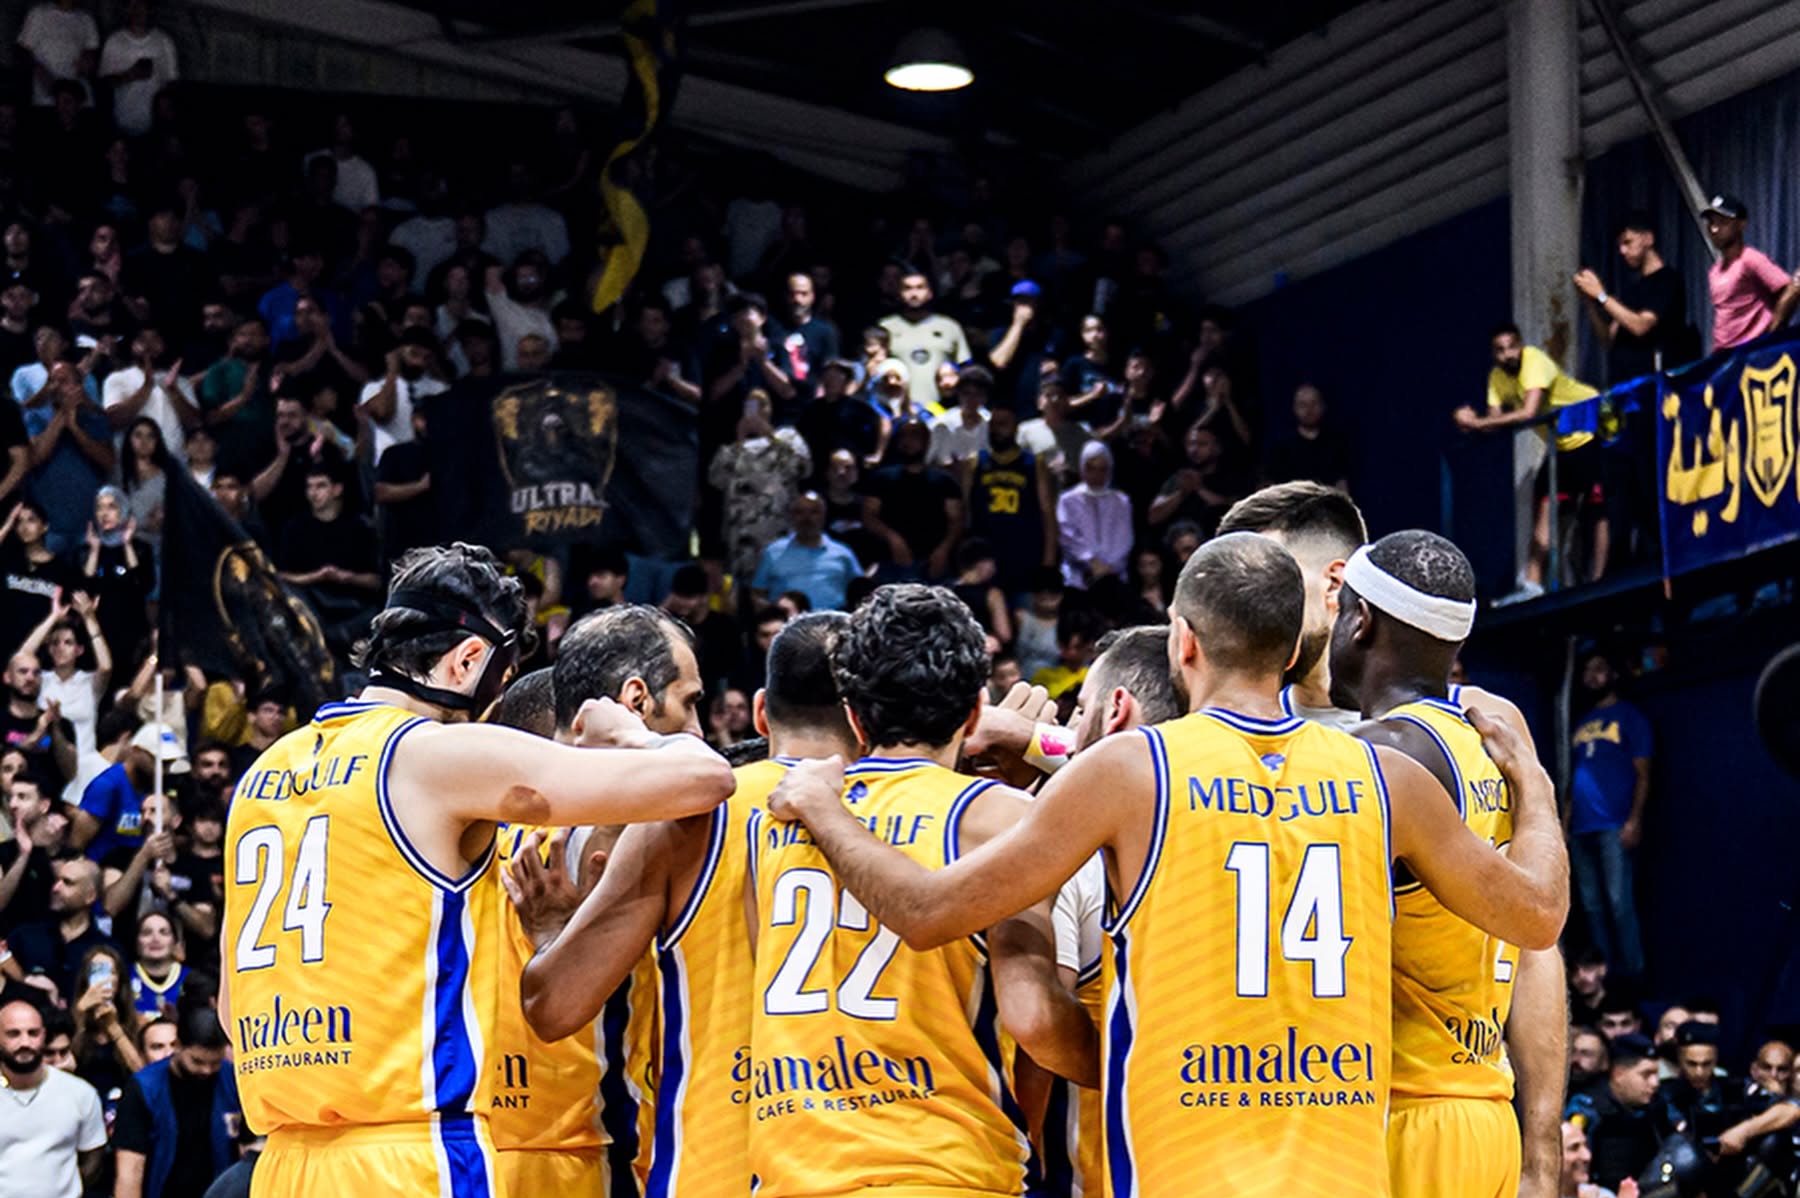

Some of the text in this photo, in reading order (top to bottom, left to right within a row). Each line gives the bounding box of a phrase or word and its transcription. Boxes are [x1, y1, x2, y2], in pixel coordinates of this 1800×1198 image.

[511, 482, 609, 513] ULTRA
[1187, 776, 1364, 822] MEDGULF
[235, 814, 332, 973] 24
[1224, 841, 1355, 998] 14
[764, 867, 902, 1021] 22
[756, 1098, 797, 1122] CAFE
[802, 1096, 816, 1111] &
[1180, 1090, 1376, 1108] CAFE & RESTAURAN
